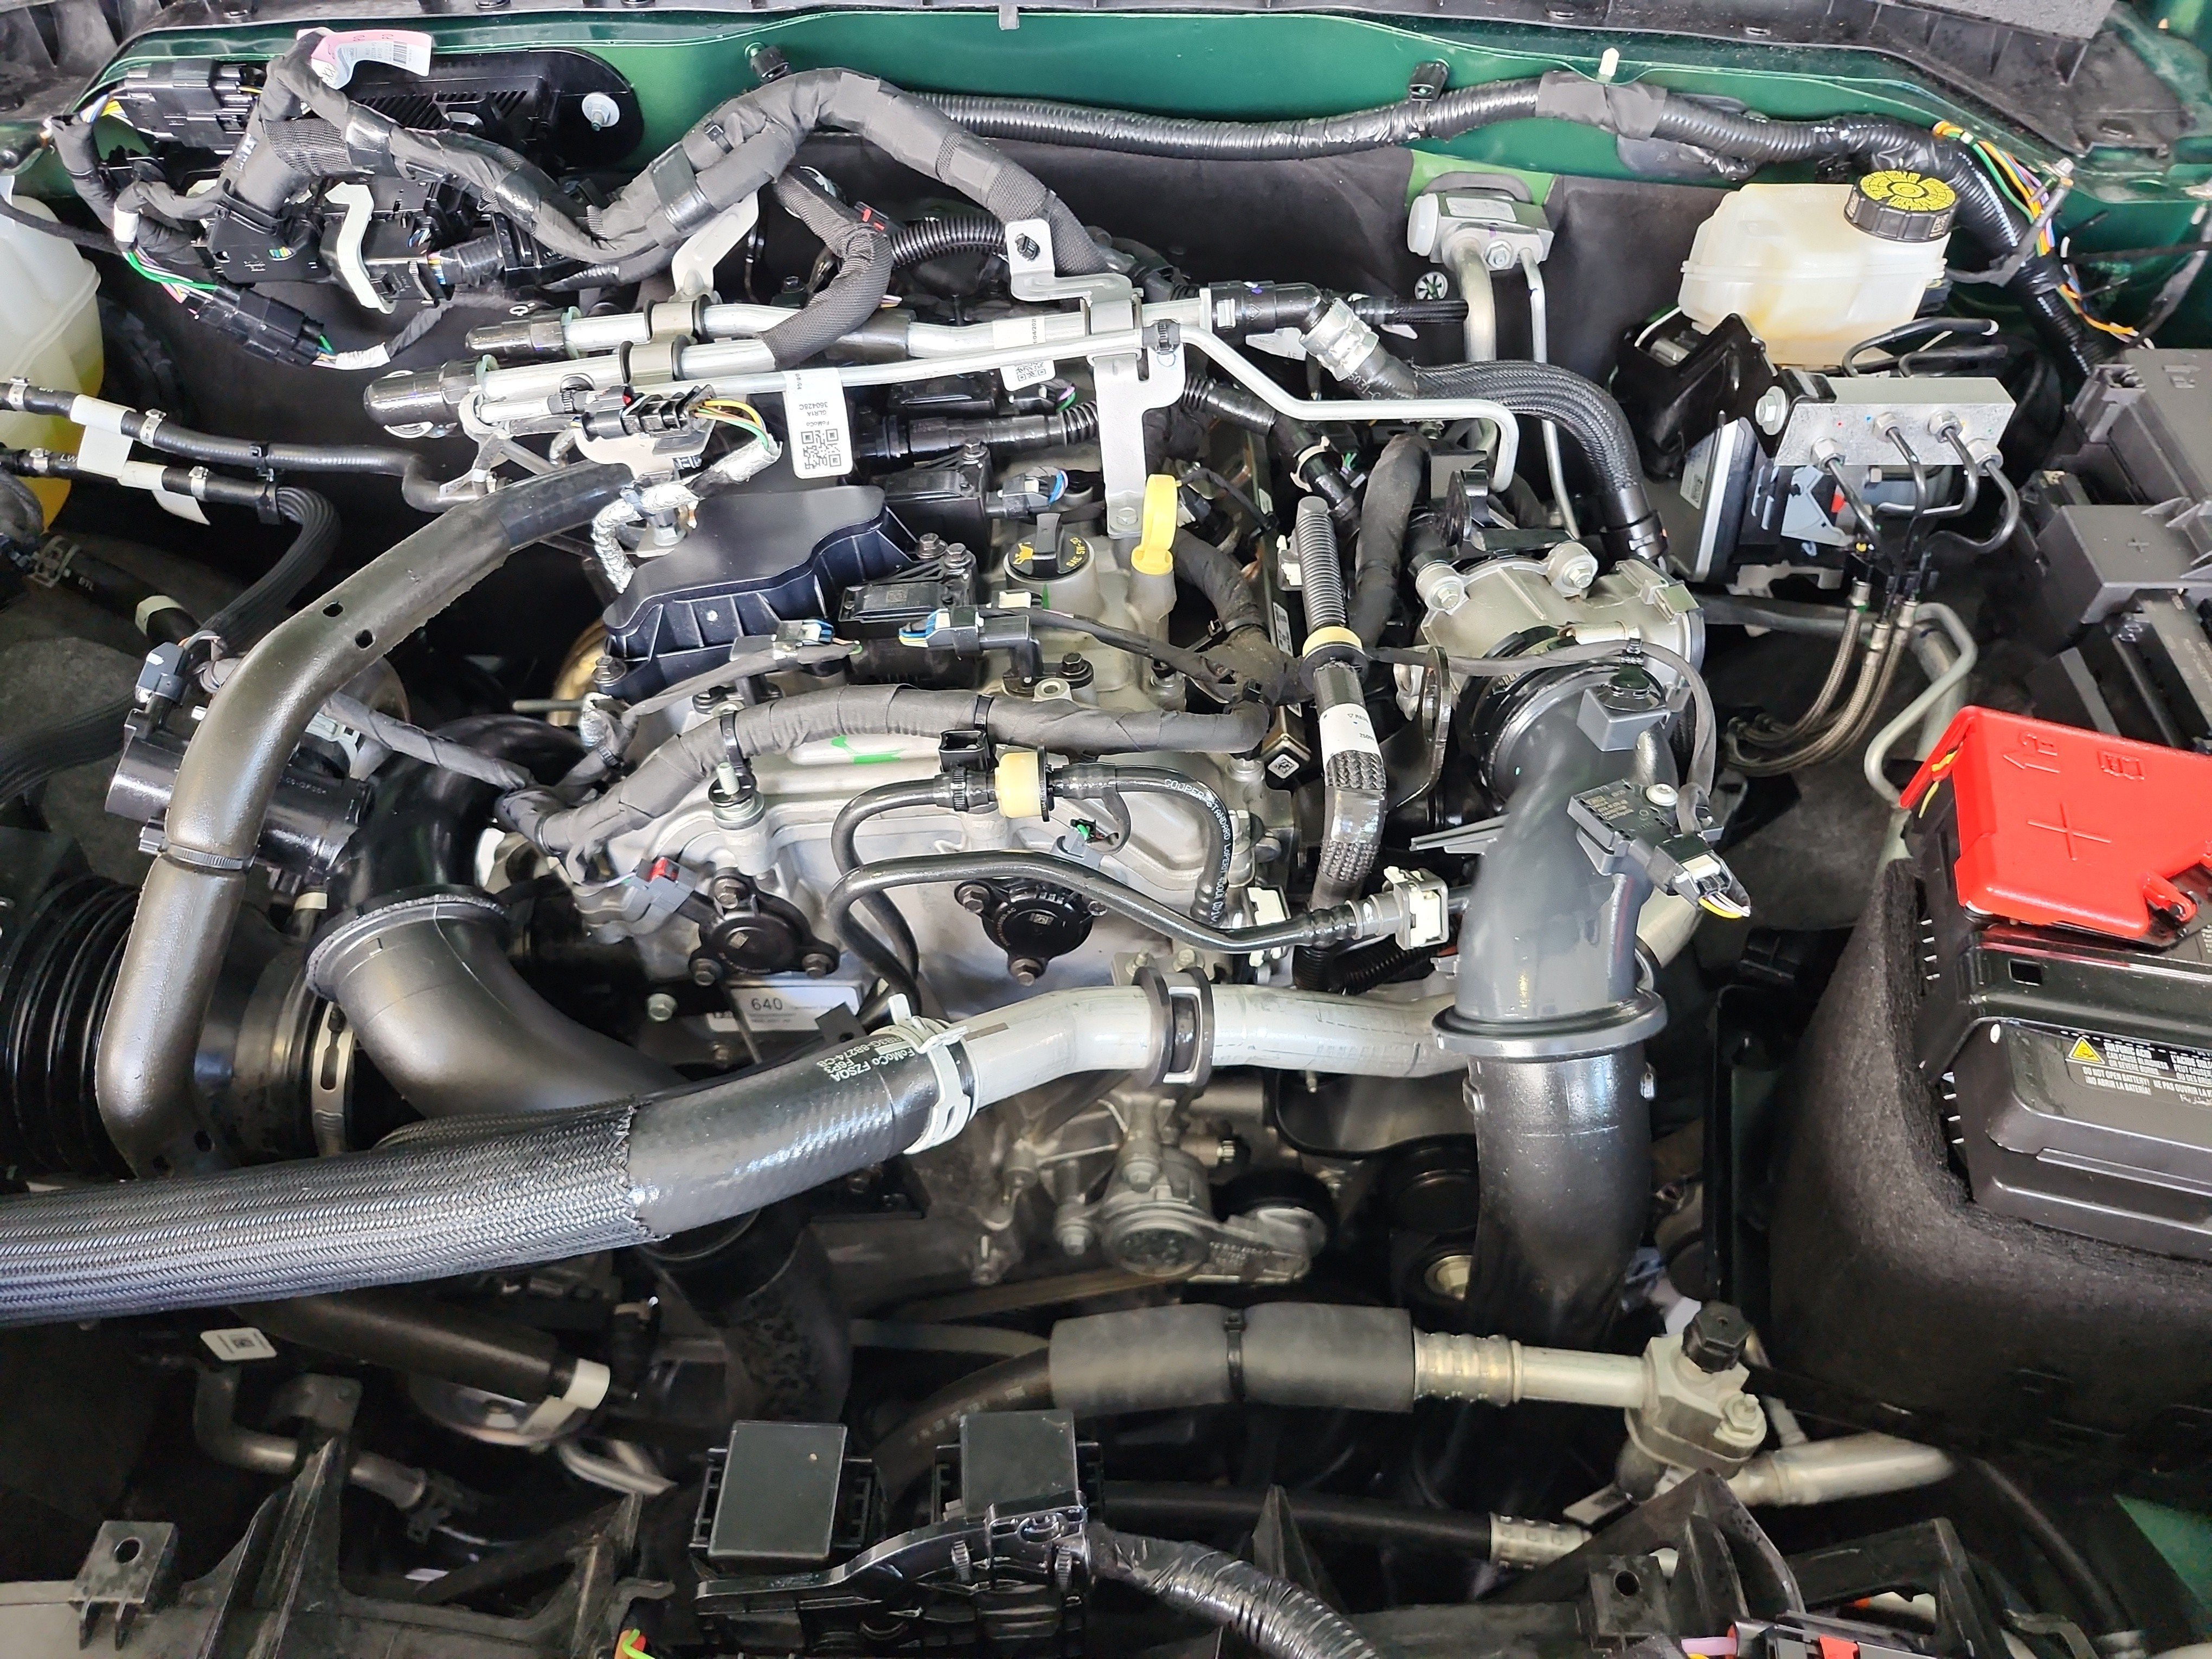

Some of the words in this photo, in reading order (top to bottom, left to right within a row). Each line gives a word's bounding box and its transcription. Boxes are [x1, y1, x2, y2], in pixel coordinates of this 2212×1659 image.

[799, 402, 828, 410] 360428C
[1066, 556, 1083, 567] SAE
[751, 998, 783, 1011] 640
[816, 1036, 903, 1068] RB3G-8B274-CB
[871, 1047, 916, 1065] FoMoCo
[2104, 1041, 2136, 1056] SULFURIC
[2136, 1047, 2152, 1059] ACID
[823, 1058, 855, 1073] F6P3
[2117, 1060, 2140, 1072] SEVERE
[2118, 1053, 2138, 1064] CAUSE
[2137, 1056, 2169, 1071] BLINDNESS
[829, 1060, 872, 1082] FZSQA
[2082, 1065, 2093, 1076] DO
[2092, 1068, 2105, 1078] NOT
[2105, 1070, 2123, 1081] OPEN
[2121, 1073, 2150, 1086] BATTERY!
[2115, 1081, 2125, 1090] LA
[2162, 1081, 2175, 1091] PAS
[2174, 1083, 2199, 1095] OUVRIR
